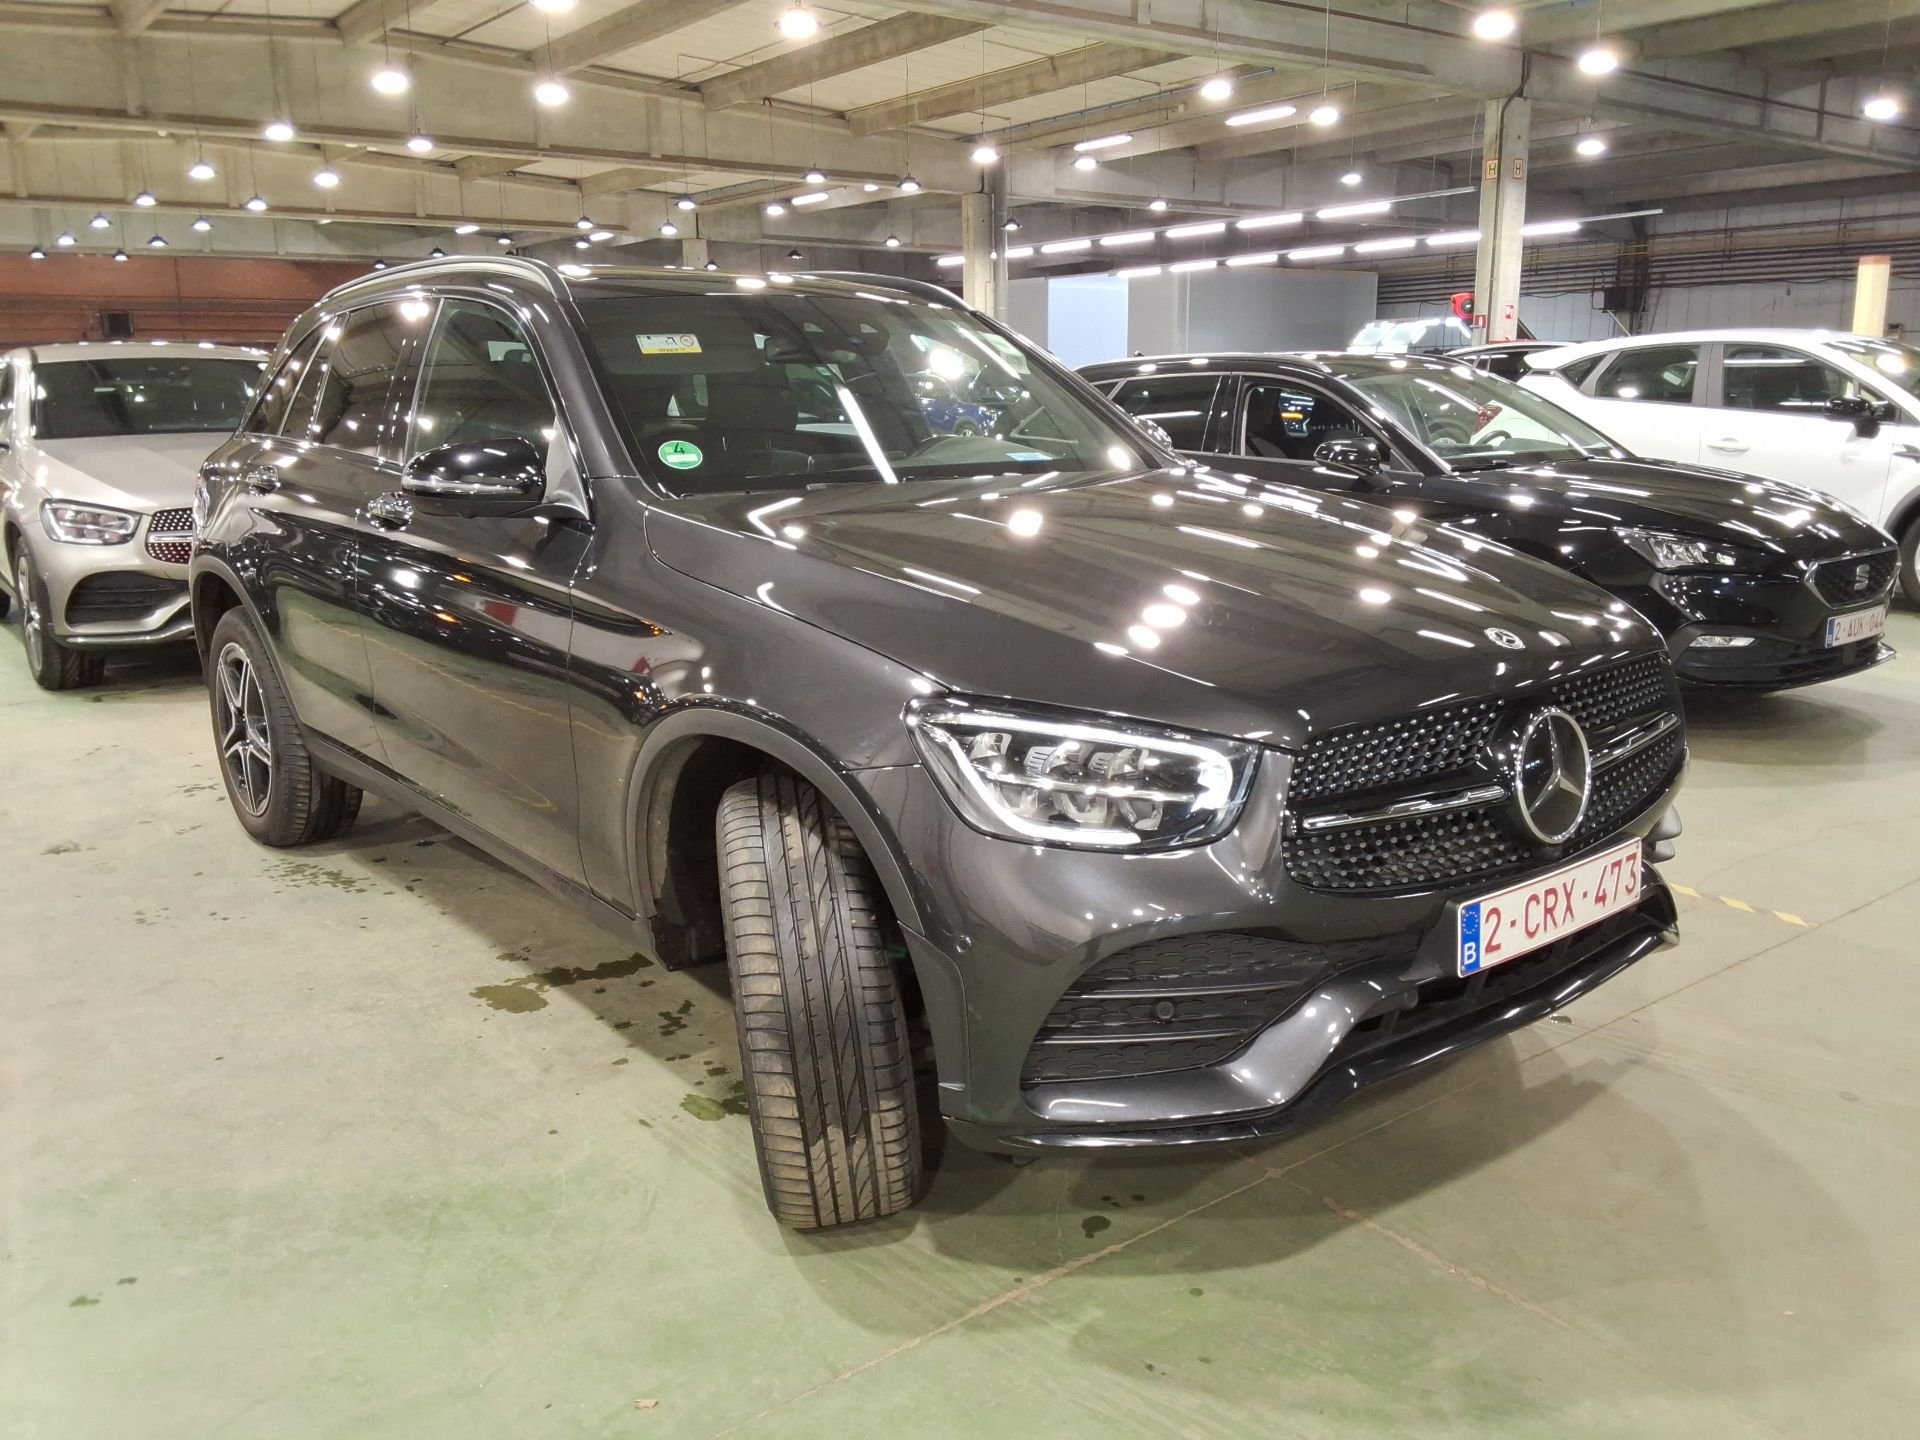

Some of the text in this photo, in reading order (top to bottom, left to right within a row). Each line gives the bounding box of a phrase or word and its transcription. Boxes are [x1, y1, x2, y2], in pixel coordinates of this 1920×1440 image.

[1488, 162, 1497, 175] H
[1515, 162, 1521, 175] H
[673, 442, 685, 454] 4
[1484, 852, 1638, 956] 2-CRX-473
[1463, 941, 1477, 966] B
